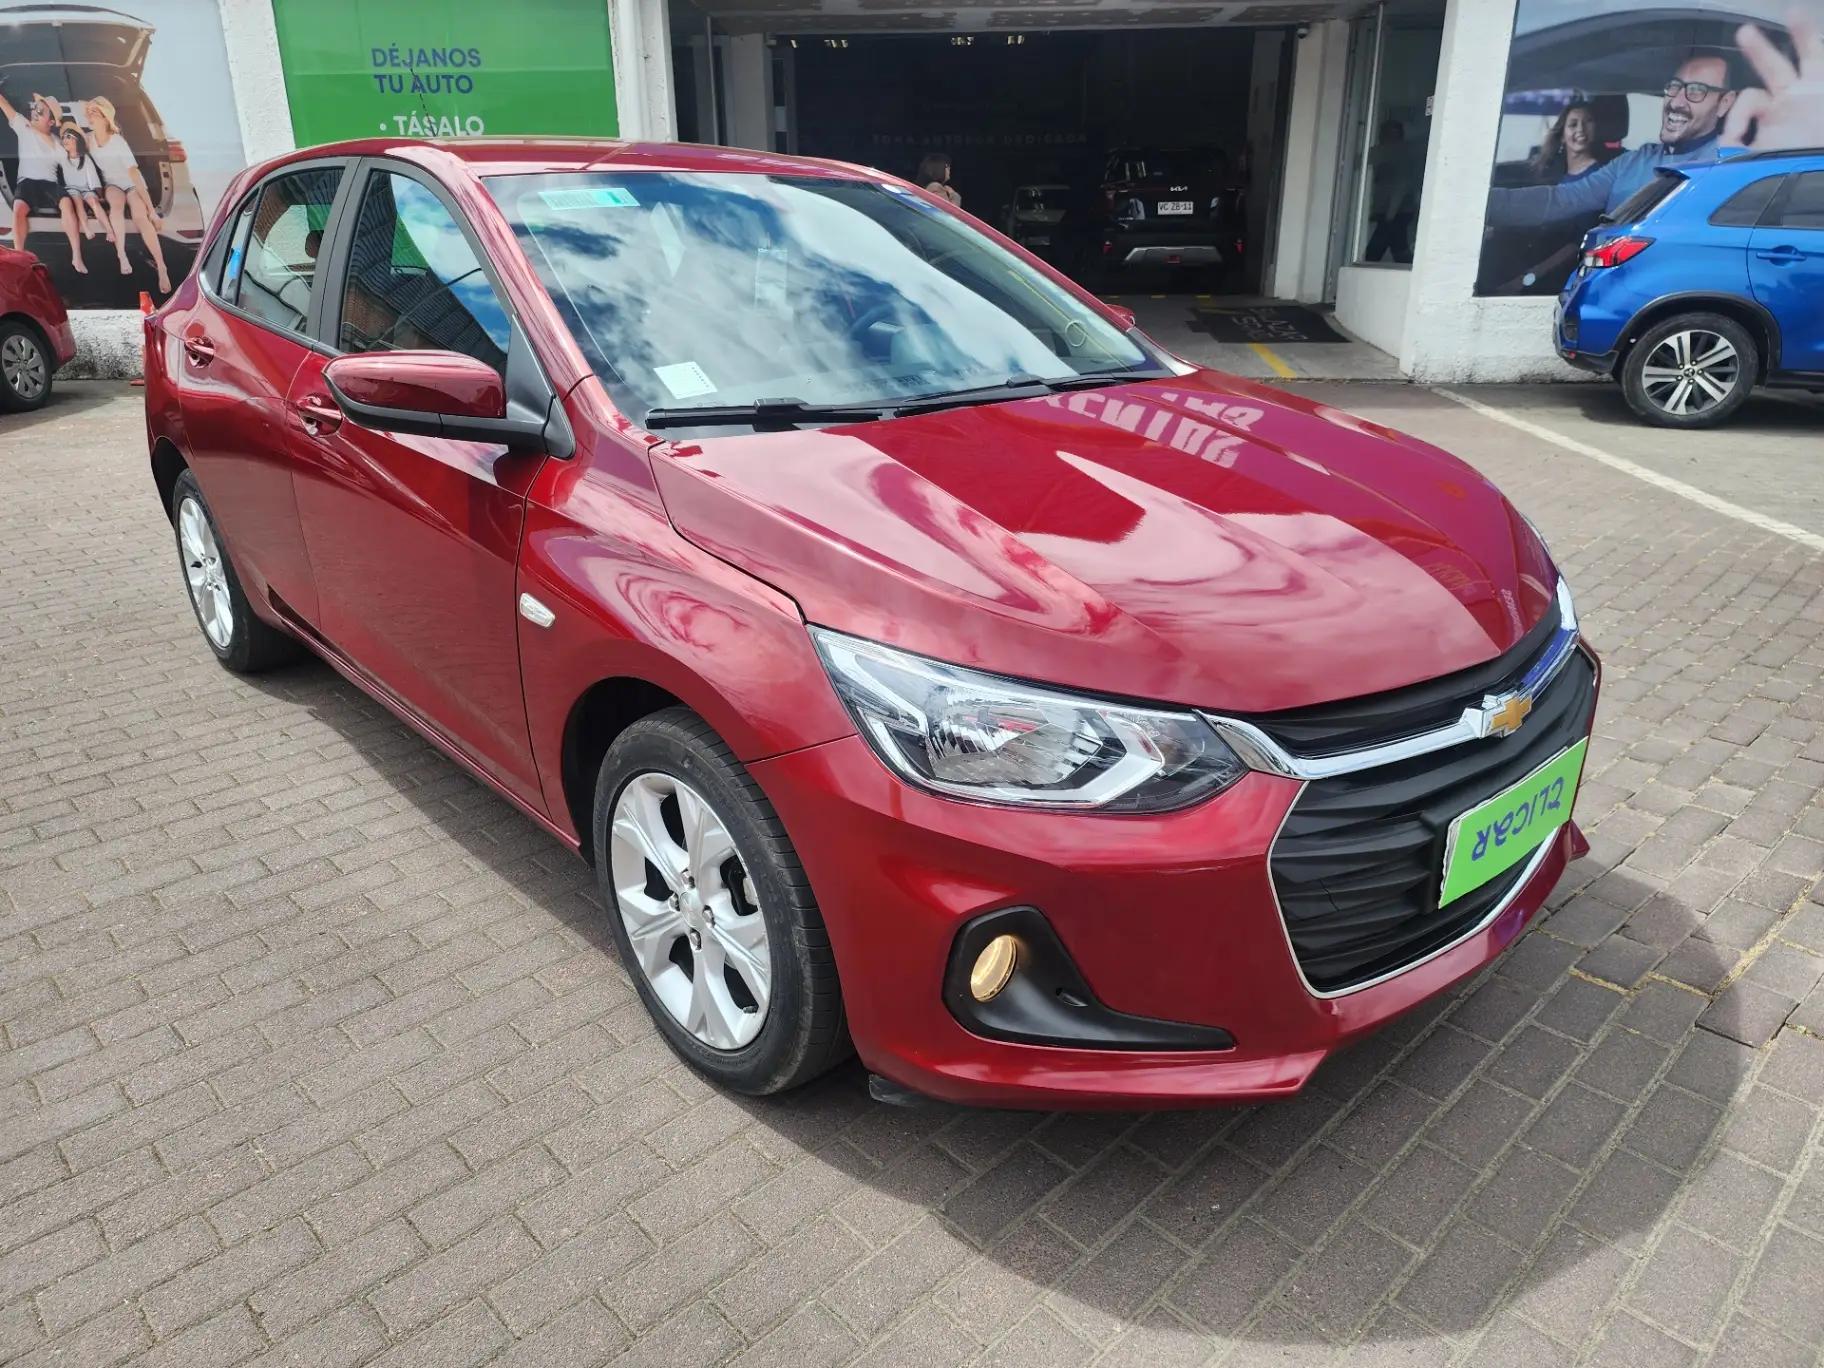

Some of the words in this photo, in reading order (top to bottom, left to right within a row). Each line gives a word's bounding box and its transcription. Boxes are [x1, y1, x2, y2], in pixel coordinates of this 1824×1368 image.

[371, 43, 482, 68] DÉJANOS
[374, 74, 404, 94] TU
[411, 74, 474, 94] AUTO
[393, 110, 485, 137] TÁSALO
